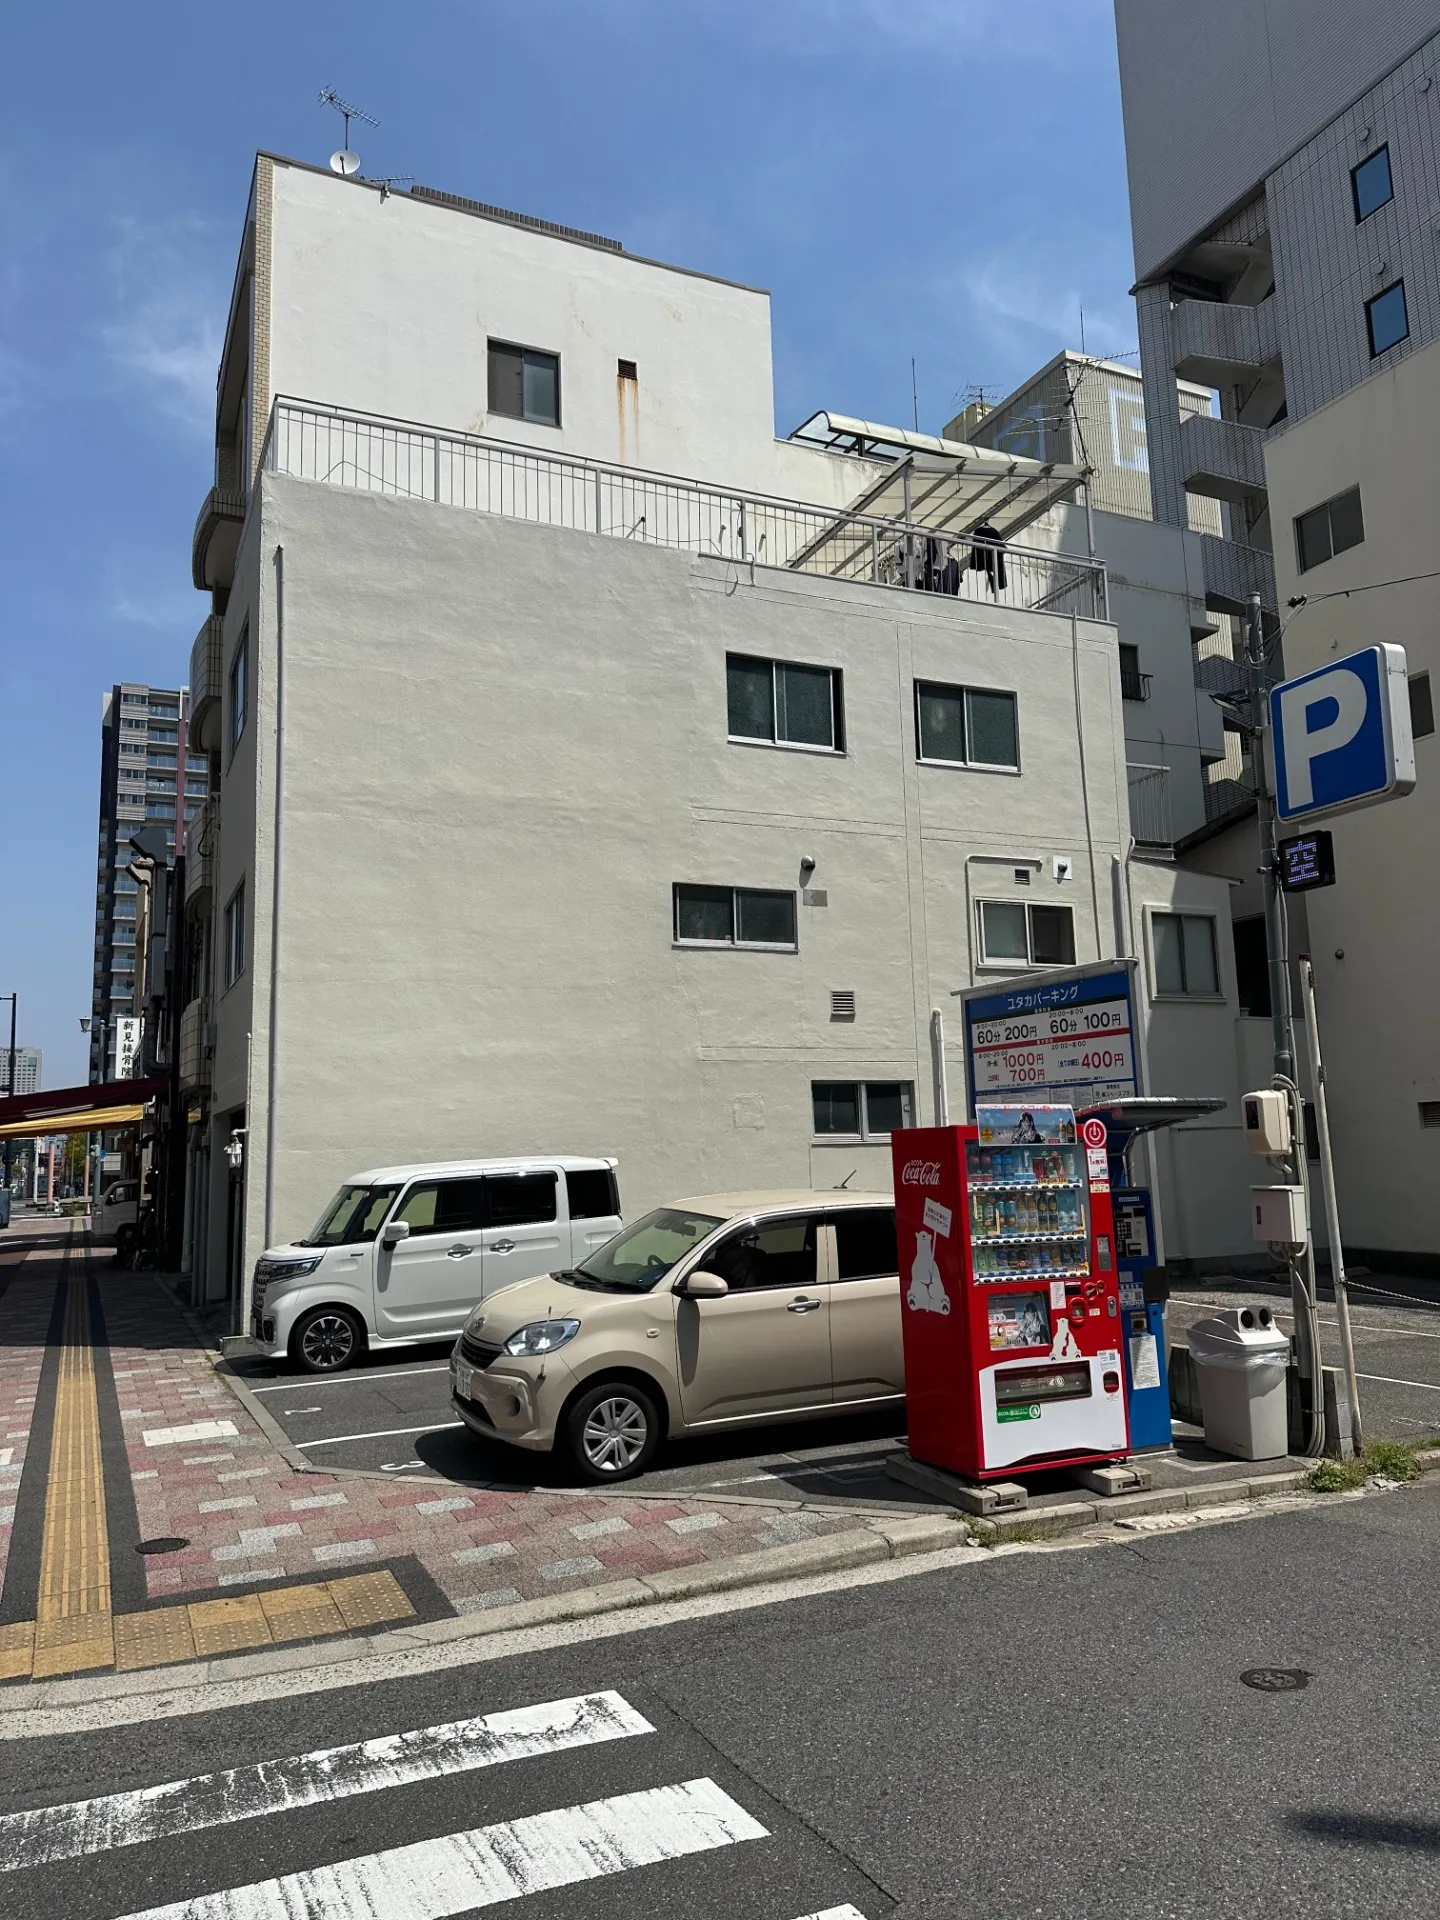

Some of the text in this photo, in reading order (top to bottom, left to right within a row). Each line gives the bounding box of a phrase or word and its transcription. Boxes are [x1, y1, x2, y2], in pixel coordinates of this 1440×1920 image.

[1280, 668, 1368, 810] P
[1050, 1012, 1121, 1034] 60分 100円
[977, 1024, 1037, 1044] 60分 200円
[1003, 1053, 1044, 1068] 1000円
[1081, 1050, 1125, 1069] 400円
[1009, 1068, 1046, 1083] 700円
[902, 1161, 941, 1186] Coca-Cola
